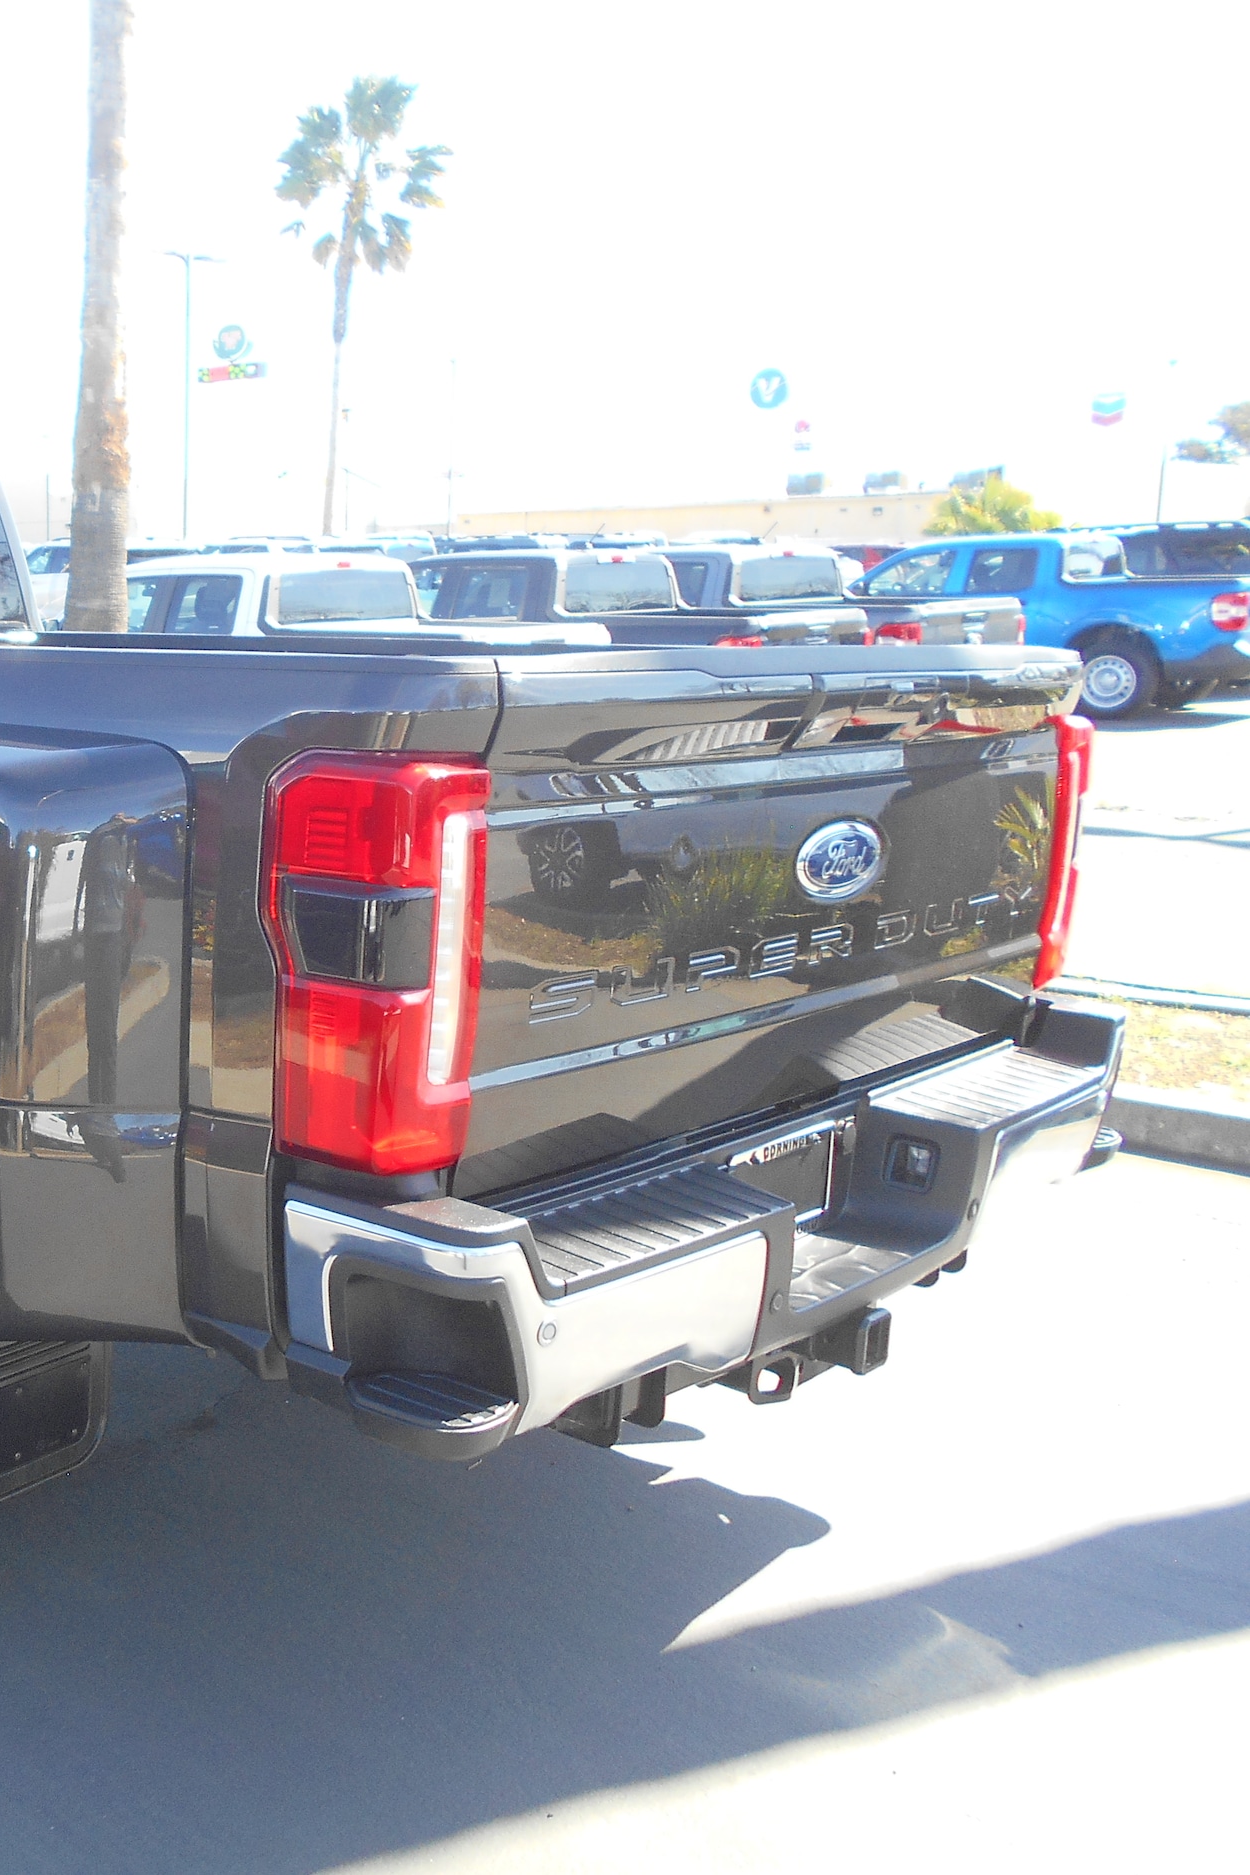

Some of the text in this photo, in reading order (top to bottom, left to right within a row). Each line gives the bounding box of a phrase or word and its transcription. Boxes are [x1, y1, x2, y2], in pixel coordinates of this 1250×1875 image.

[821, 839, 867, 879] Ford
[528, 886, 1035, 1025] SUPER DUTY
